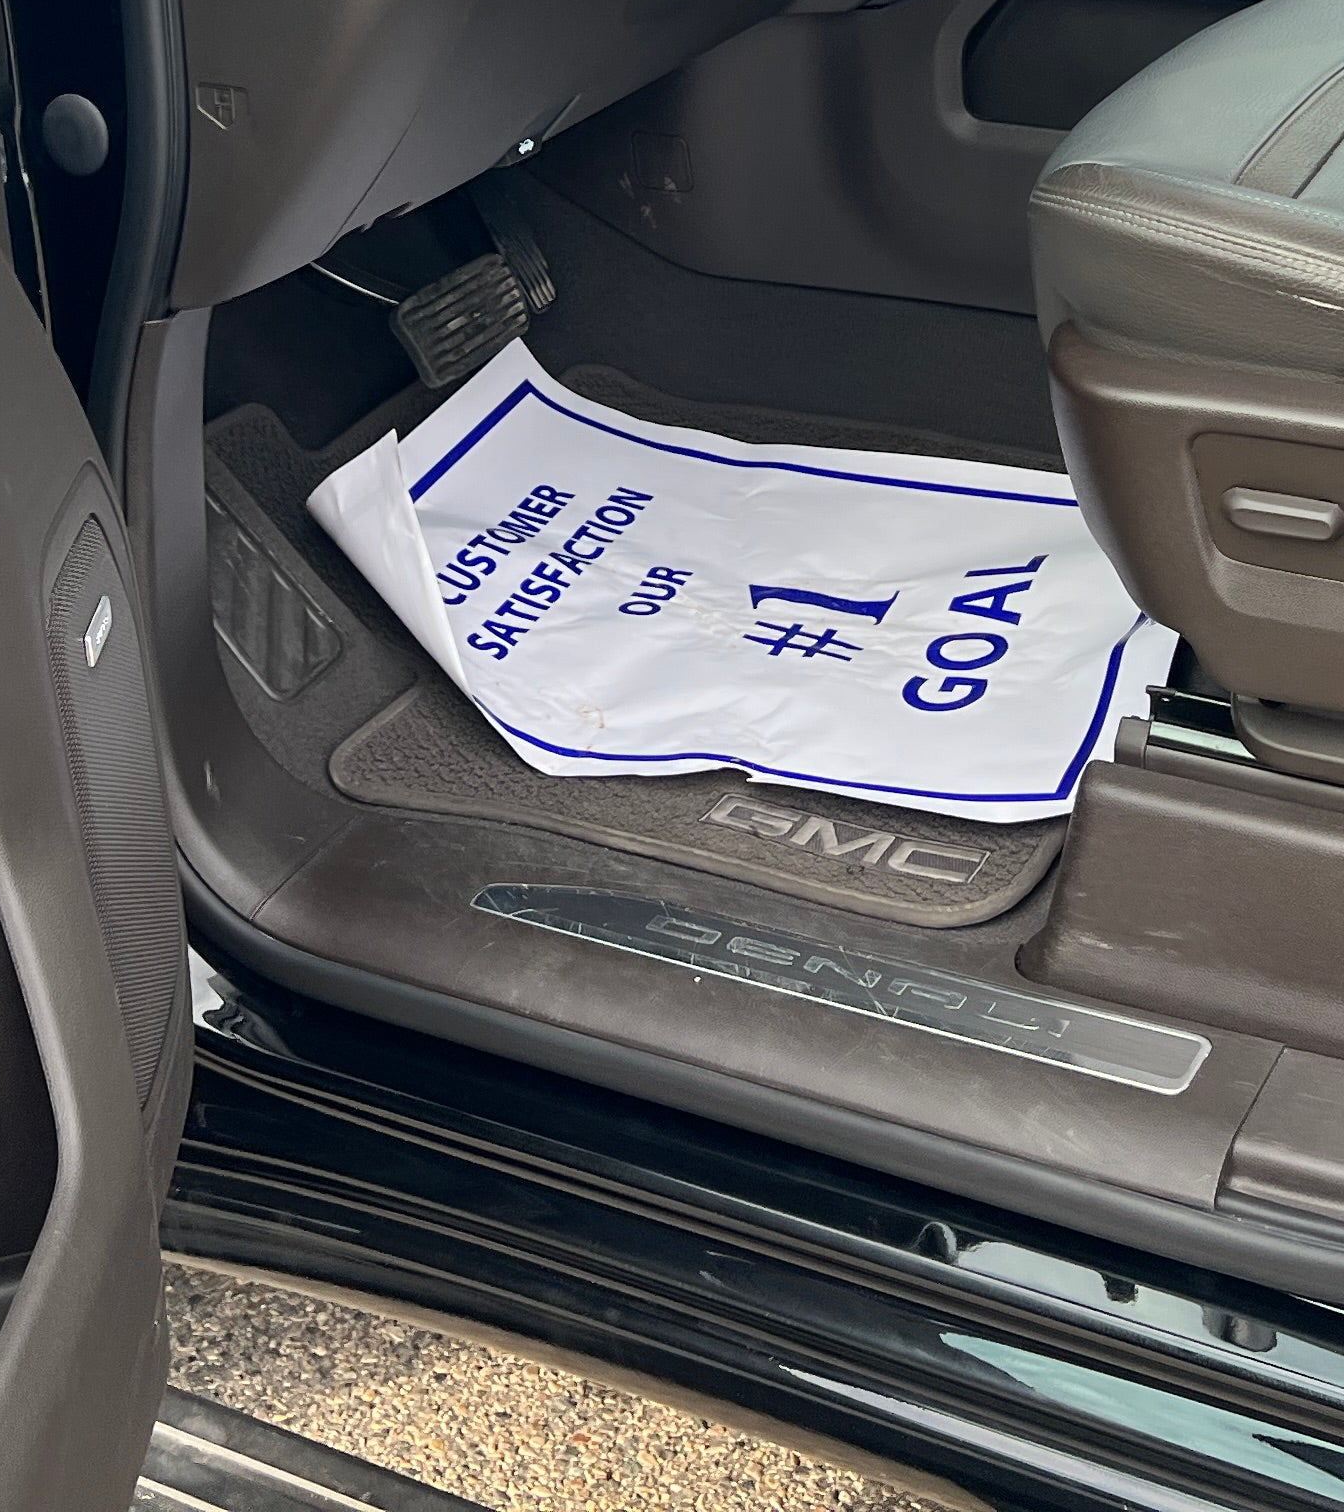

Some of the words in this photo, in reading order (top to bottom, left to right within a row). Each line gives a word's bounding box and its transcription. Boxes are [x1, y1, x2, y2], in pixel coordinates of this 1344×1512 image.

[467, 487, 654, 661] SATISFACTION
[618, 566, 693, 616] OUR
[743, 583, 899, 662] #1
[902, 555, 1048, 712] GOAL
[709, 803, 984, 883] GMC
